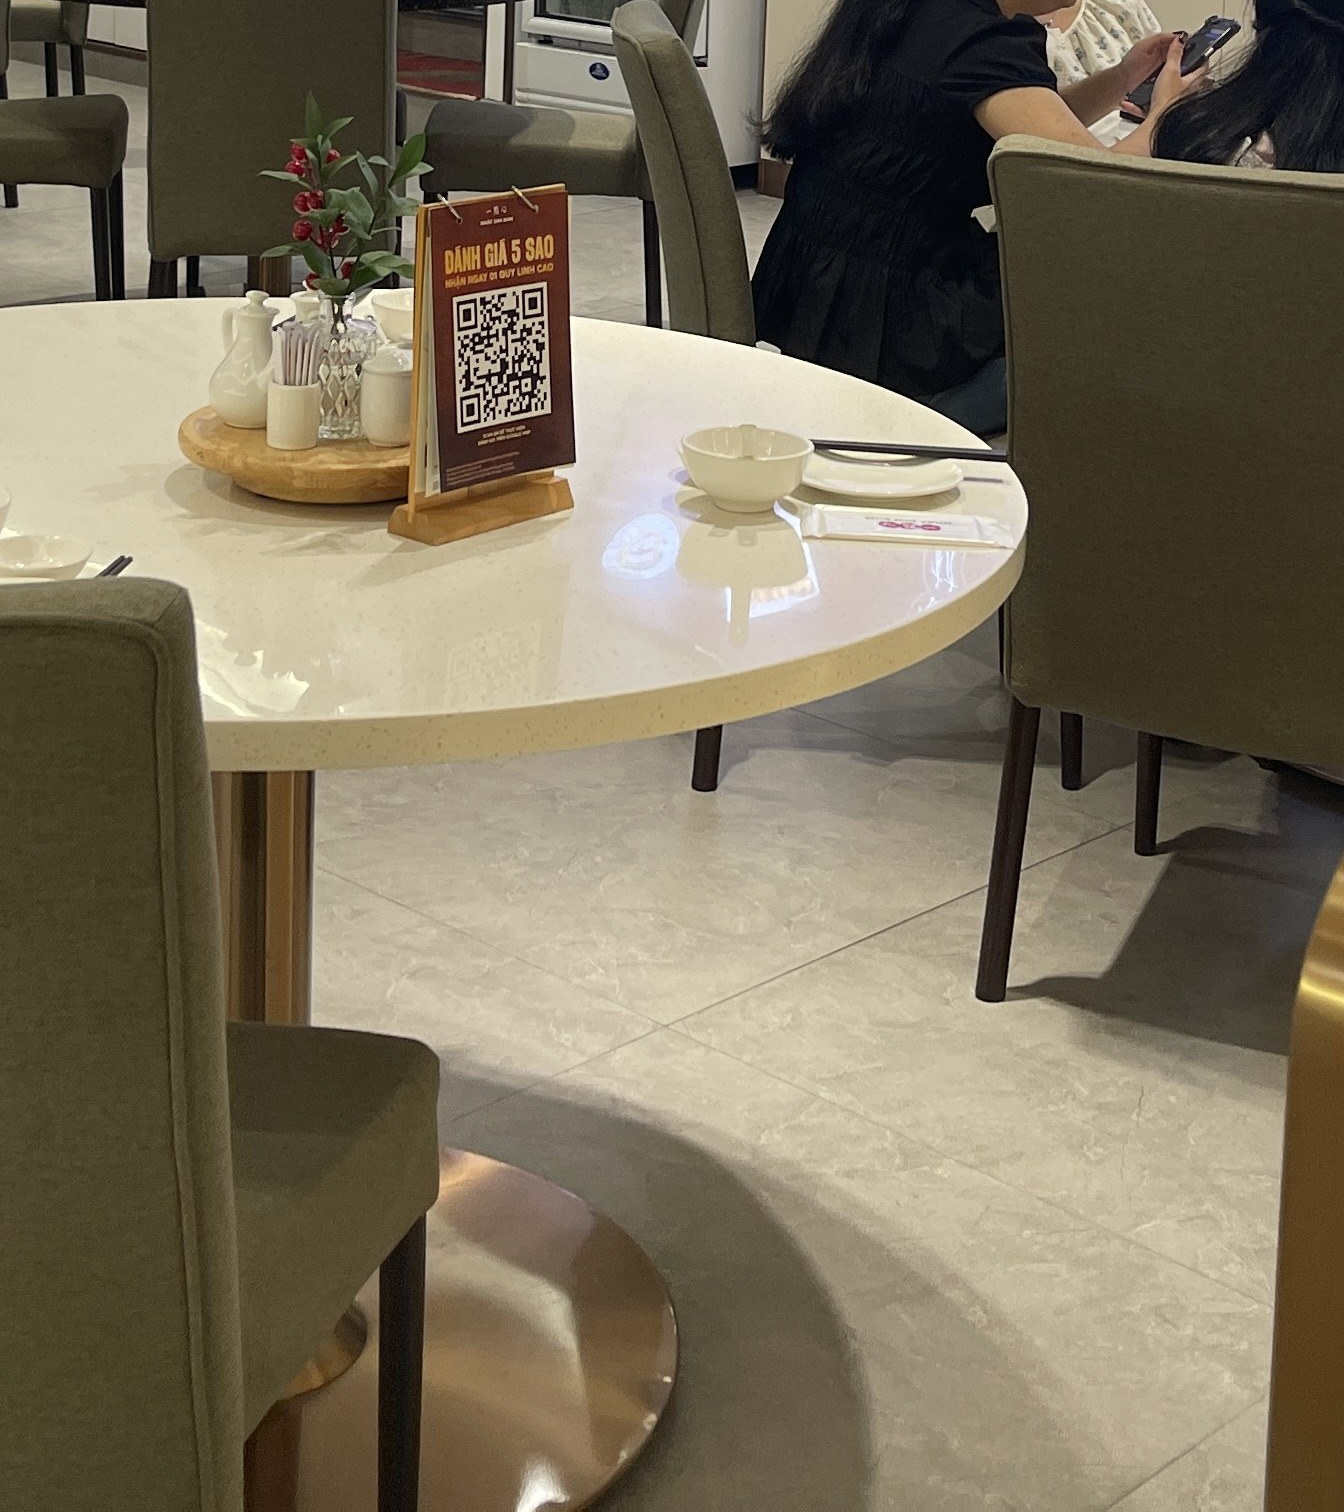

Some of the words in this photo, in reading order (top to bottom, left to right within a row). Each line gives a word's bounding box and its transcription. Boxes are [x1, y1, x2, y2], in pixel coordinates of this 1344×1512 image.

[444, 245, 481, 275] ĐÁNH
[484, 238, 508, 268] GIÁ
[511, 238, 521, 264] 5
[525, 234, 554, 262] SAO
[536, 263, 554, 273] CAO
